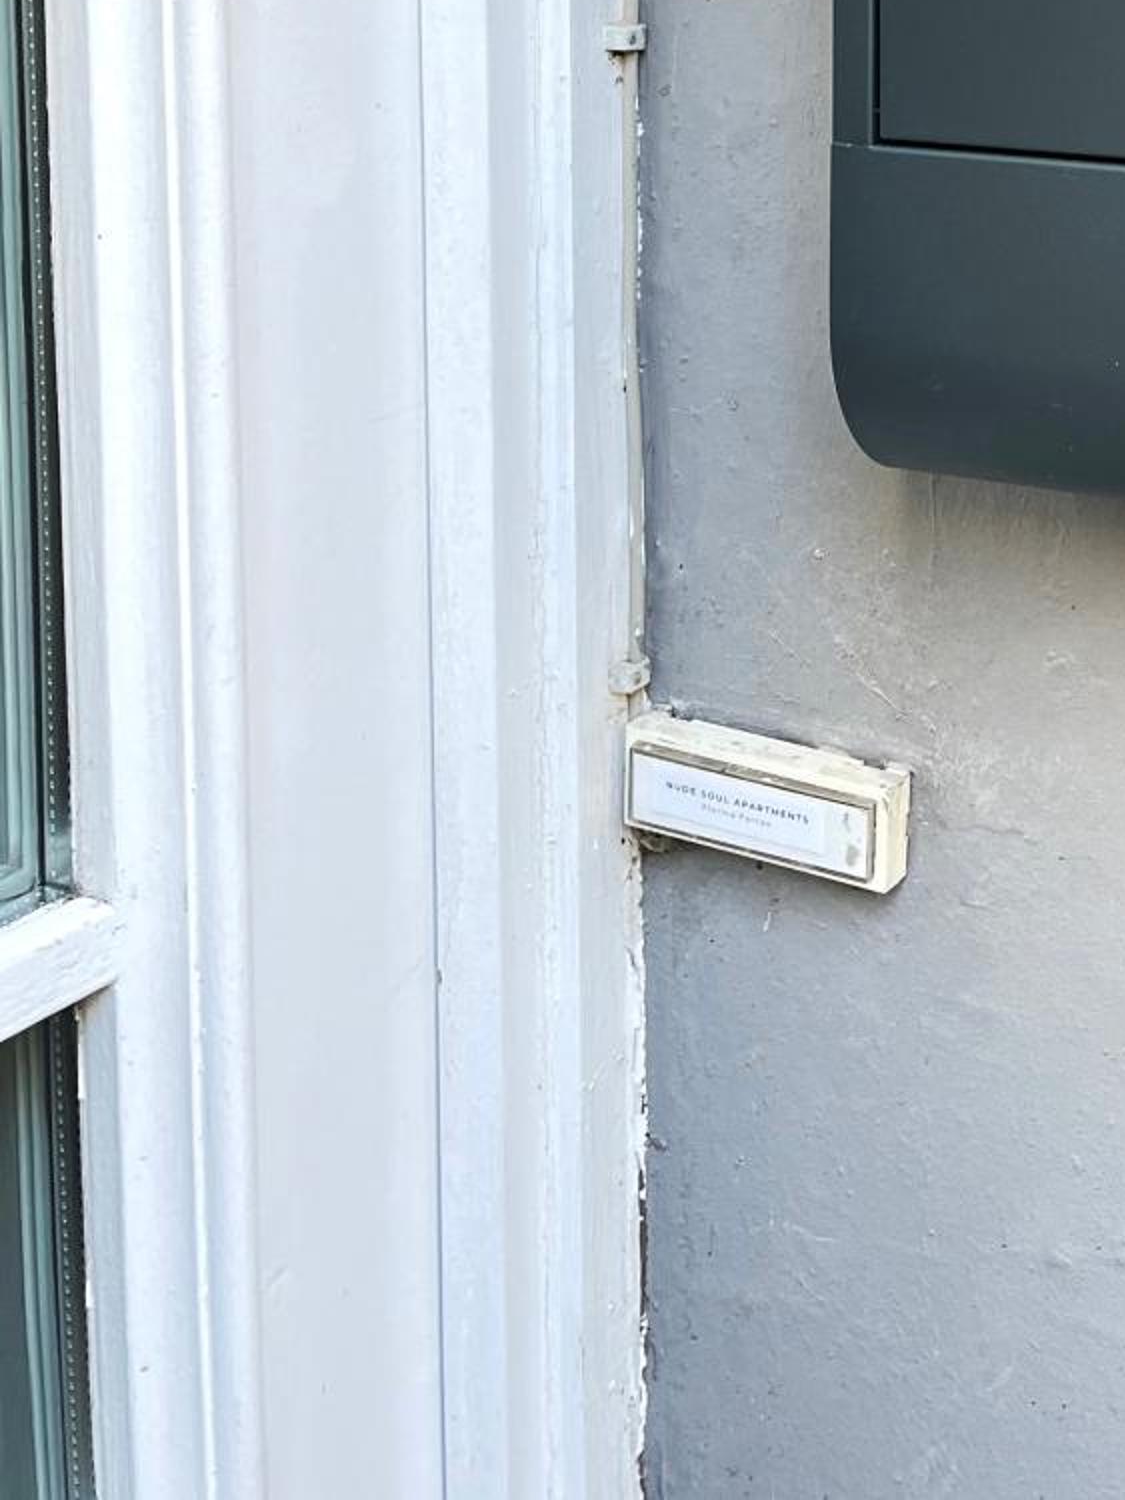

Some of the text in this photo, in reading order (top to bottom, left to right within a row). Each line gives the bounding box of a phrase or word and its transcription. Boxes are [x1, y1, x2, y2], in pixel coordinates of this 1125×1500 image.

[665, 780, 810, 826] NUDE SOUL APARTMENTS
